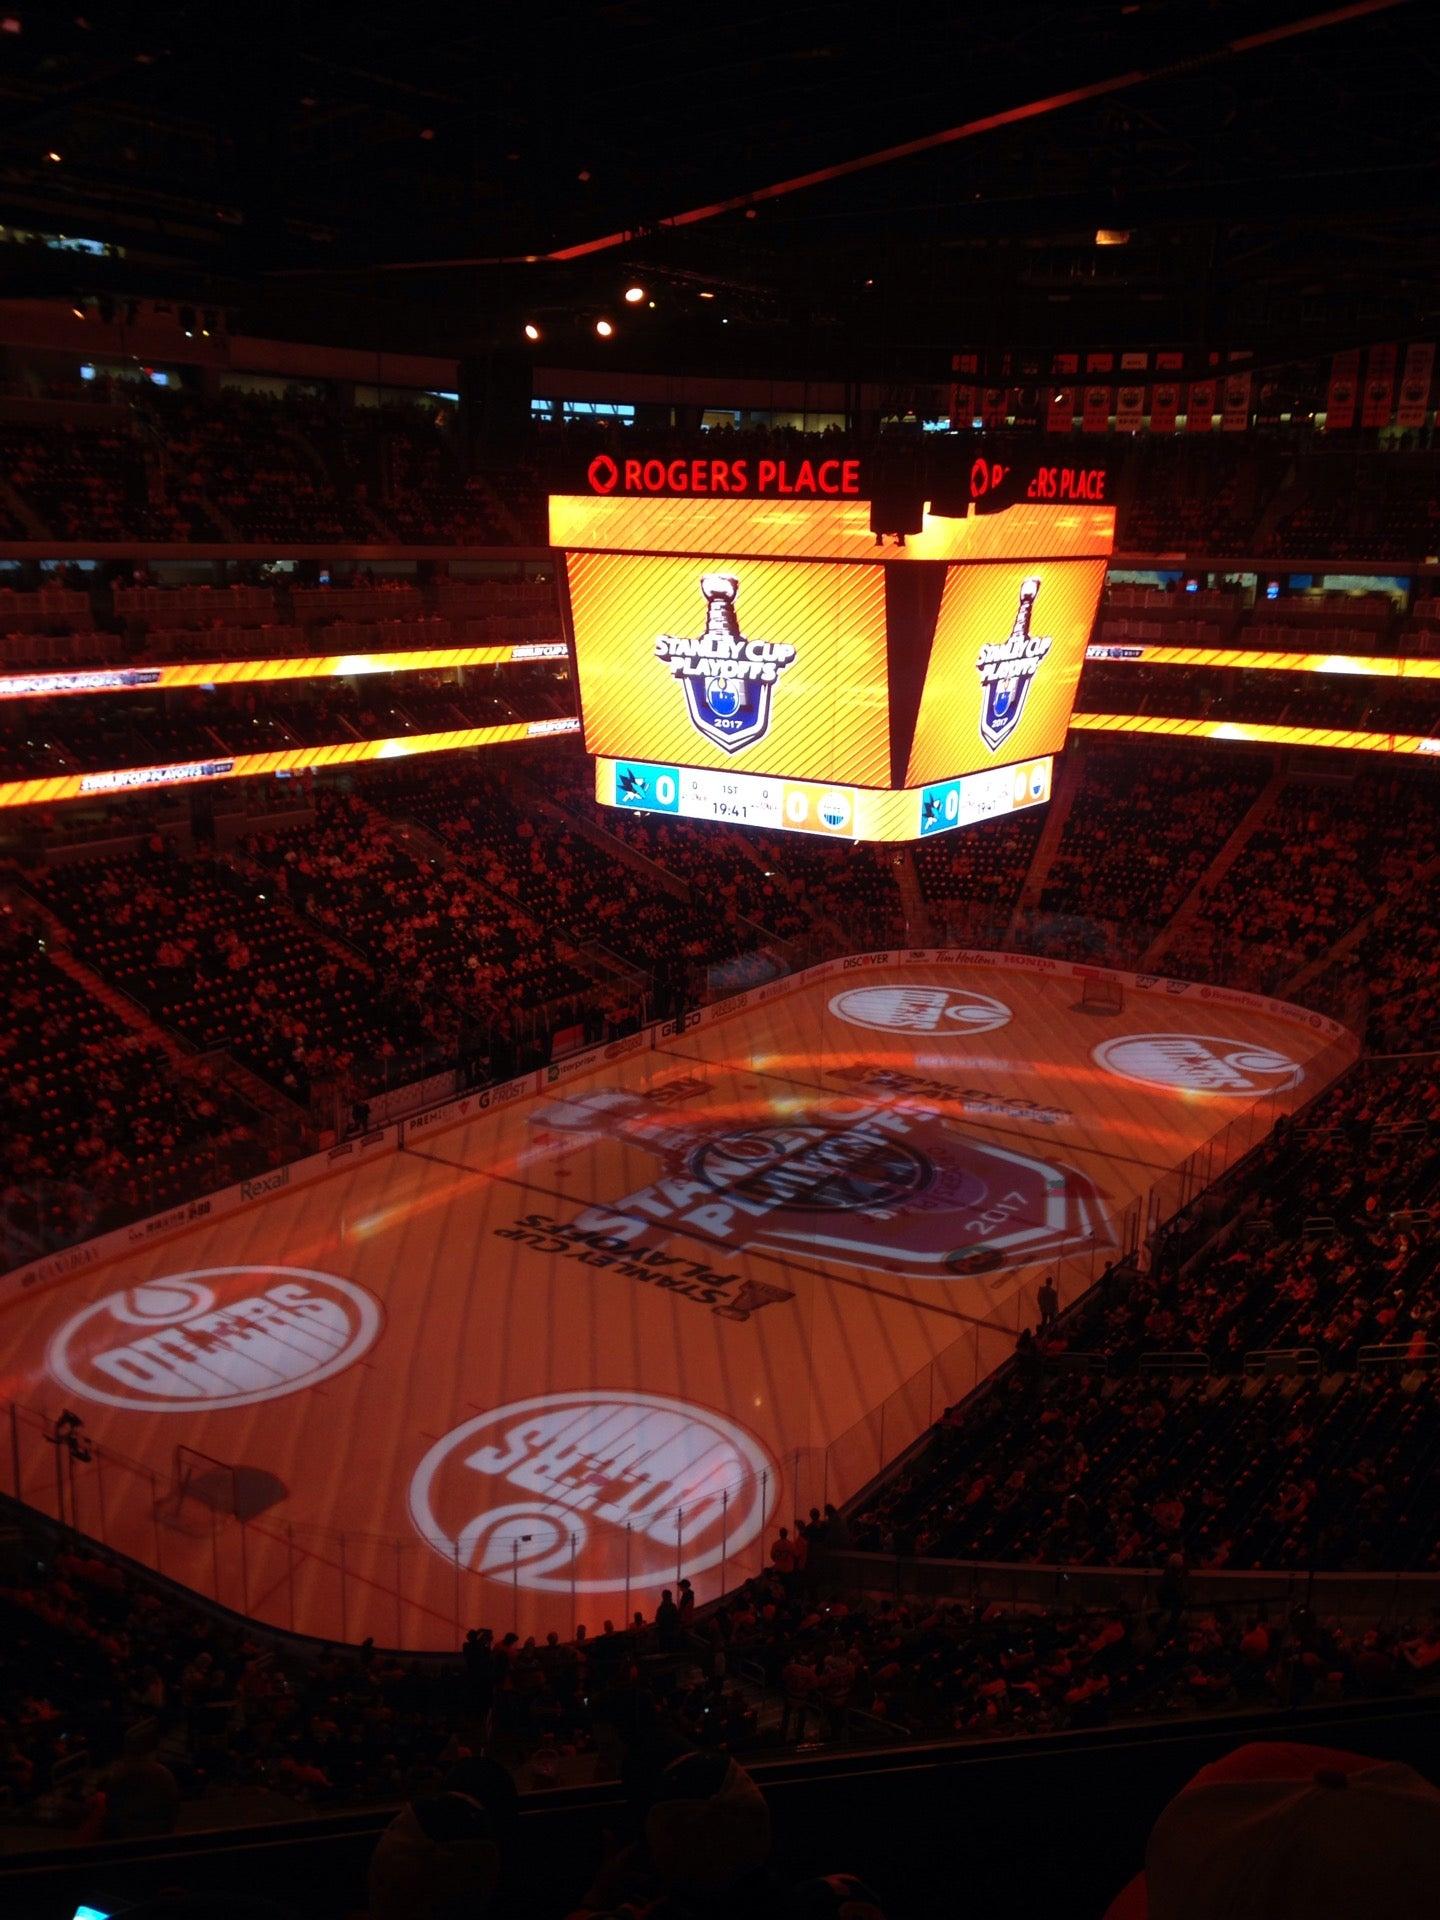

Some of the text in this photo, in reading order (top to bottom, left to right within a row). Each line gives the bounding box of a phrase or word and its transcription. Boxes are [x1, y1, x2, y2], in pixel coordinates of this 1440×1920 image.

[625, 459, 860, 493] ROGERS PLACE
[1060, 469, 1106, 499] PLACE
[655, 636, 795, 663] STANLEY CUP
[671, 657, 777, 681] PLAYOFFS
[714, 718, 743, 728] 2017
[656, 774, 676, 804] 0
[722, 785, 738, 795] 1ST
[713, 802, 748, 818] 19:41
[936, 951, 953, 963] Tim
[955, 952, 996, 965] Hortons
[1004, 955, 1056, 969] HONDA
[240, 1166, 290, 1202] Rexall
[963, 1190, 1028, 1235] 2017
[494, 1227, 731, 1304] STANLEY CUP
[514, 1214, 742, 1287] PLAYOFFS
